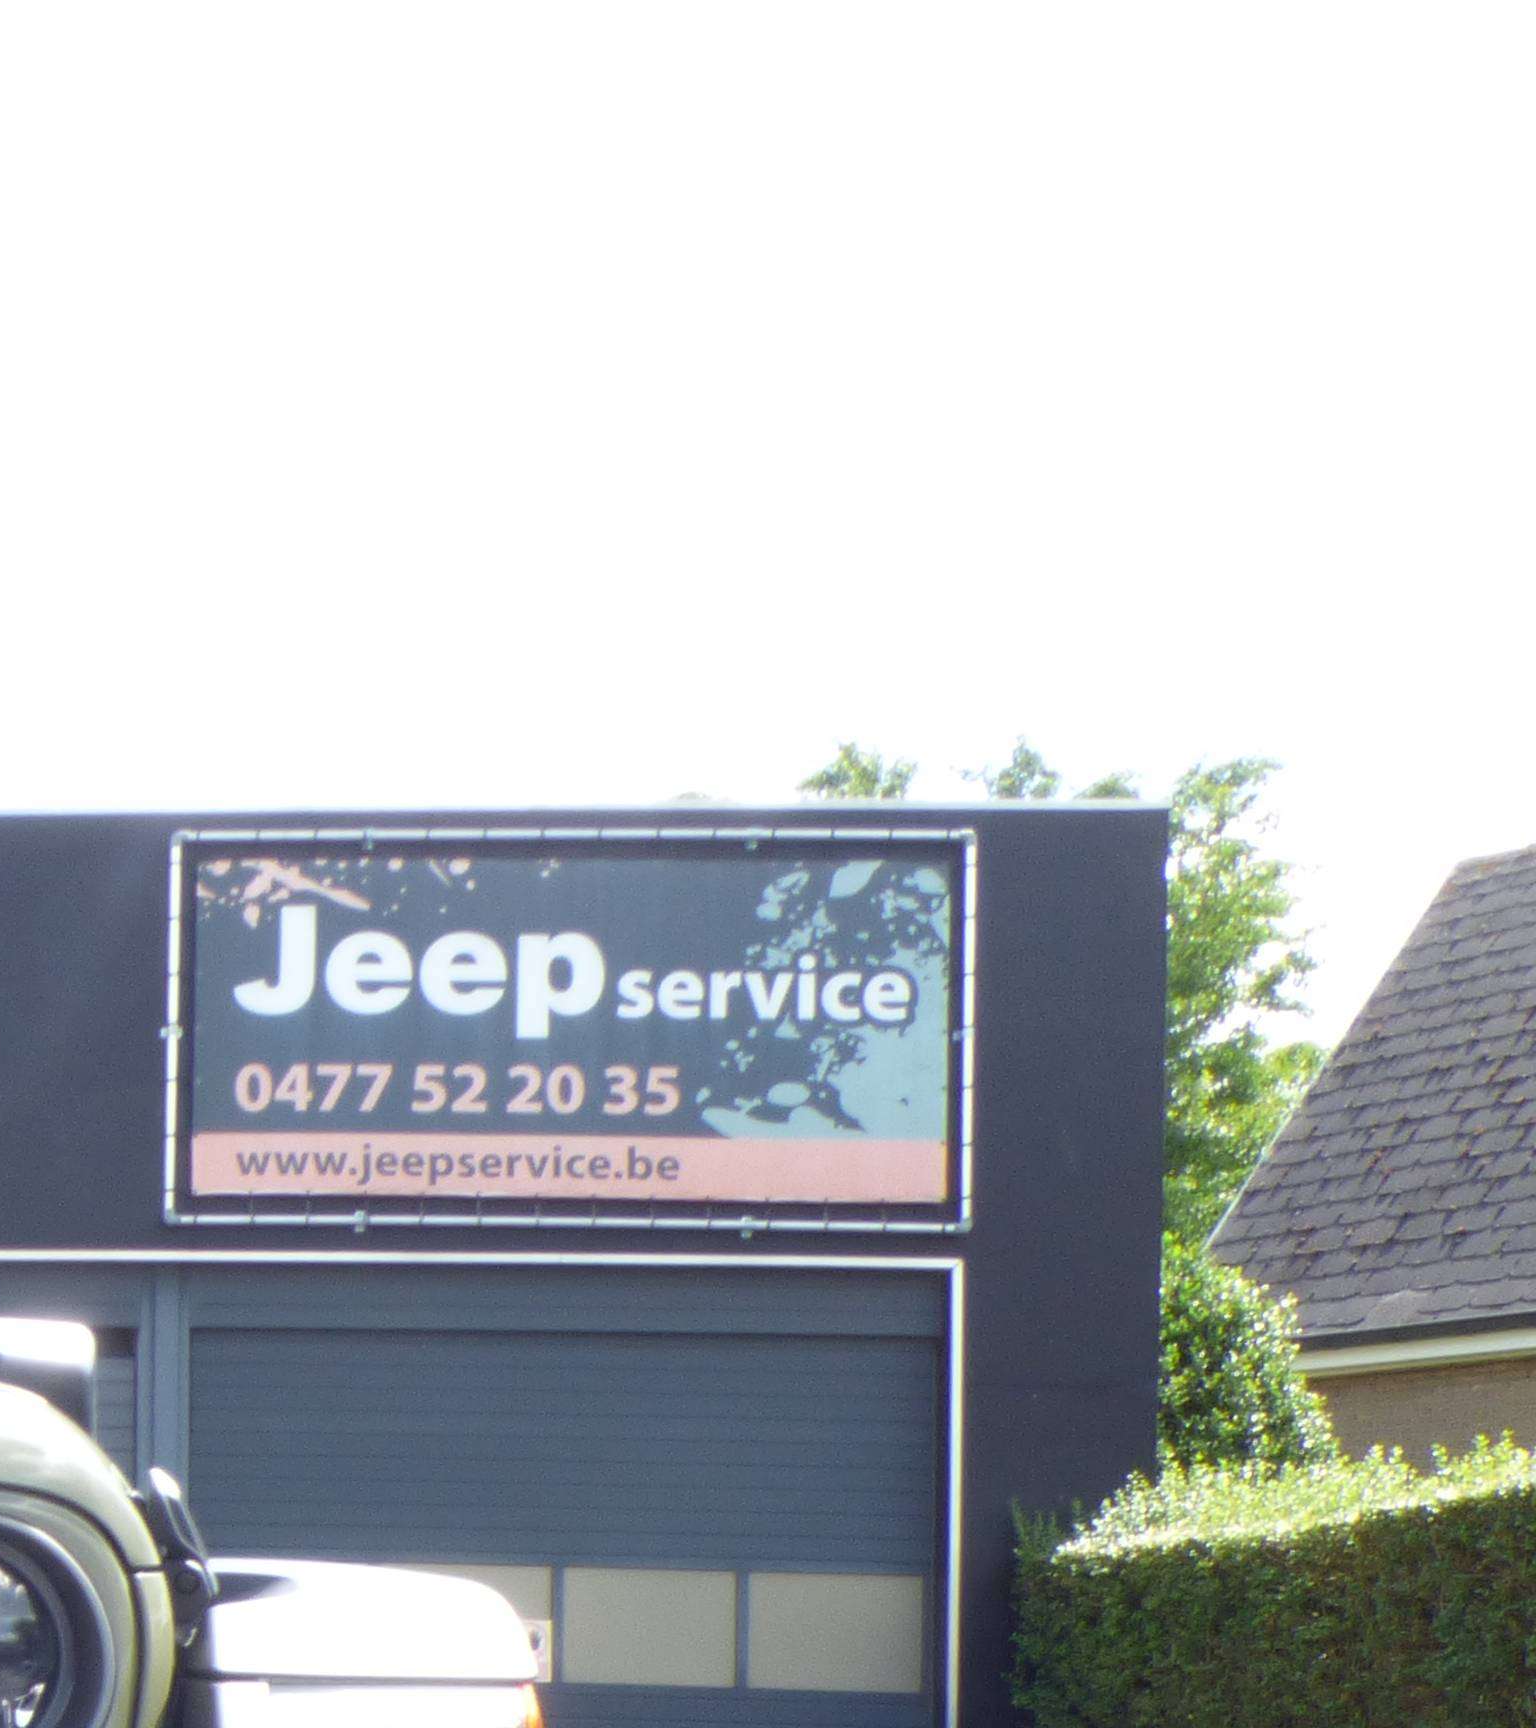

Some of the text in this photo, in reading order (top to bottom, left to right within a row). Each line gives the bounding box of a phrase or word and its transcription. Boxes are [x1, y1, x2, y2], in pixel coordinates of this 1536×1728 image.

[233, 904, 913, 1040] Jeep service
[234, 1063, 682, 1116] 0477 52 20 35
[236, 1143, 681, 1185] www.jeepservice.be
